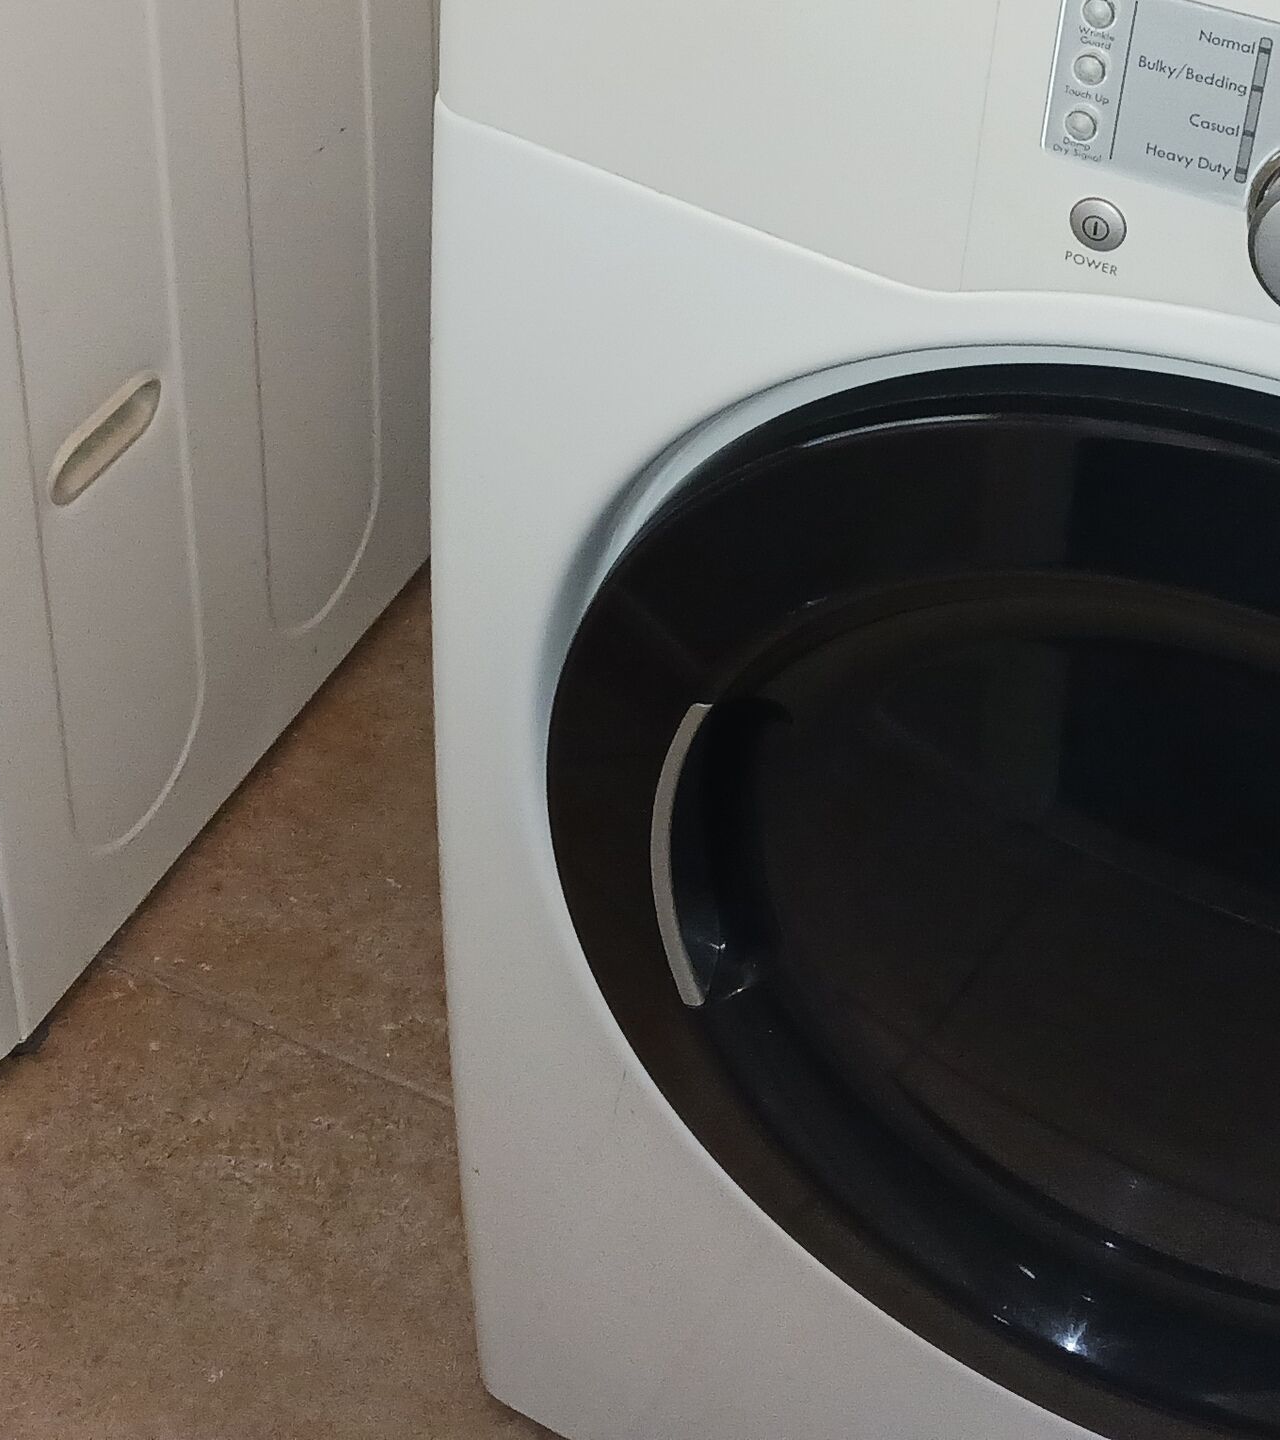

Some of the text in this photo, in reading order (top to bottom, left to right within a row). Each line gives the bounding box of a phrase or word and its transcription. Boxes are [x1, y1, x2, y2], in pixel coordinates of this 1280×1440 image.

[1078, 25, 1115, 42] Wrinkle
[1080, 36, 1112, 50] Guard
[1198, 29, 1256, 55] Normal
[1138, 55, 1248, 97] Bulky/Bedding
[1064, 85, 1110, 106] Touch Up
[1189, 113, 1240, 138] Casual
[1145, 143, 1232, 180] Heavy Duty
[1064, 250, 1120, 278] POWER
